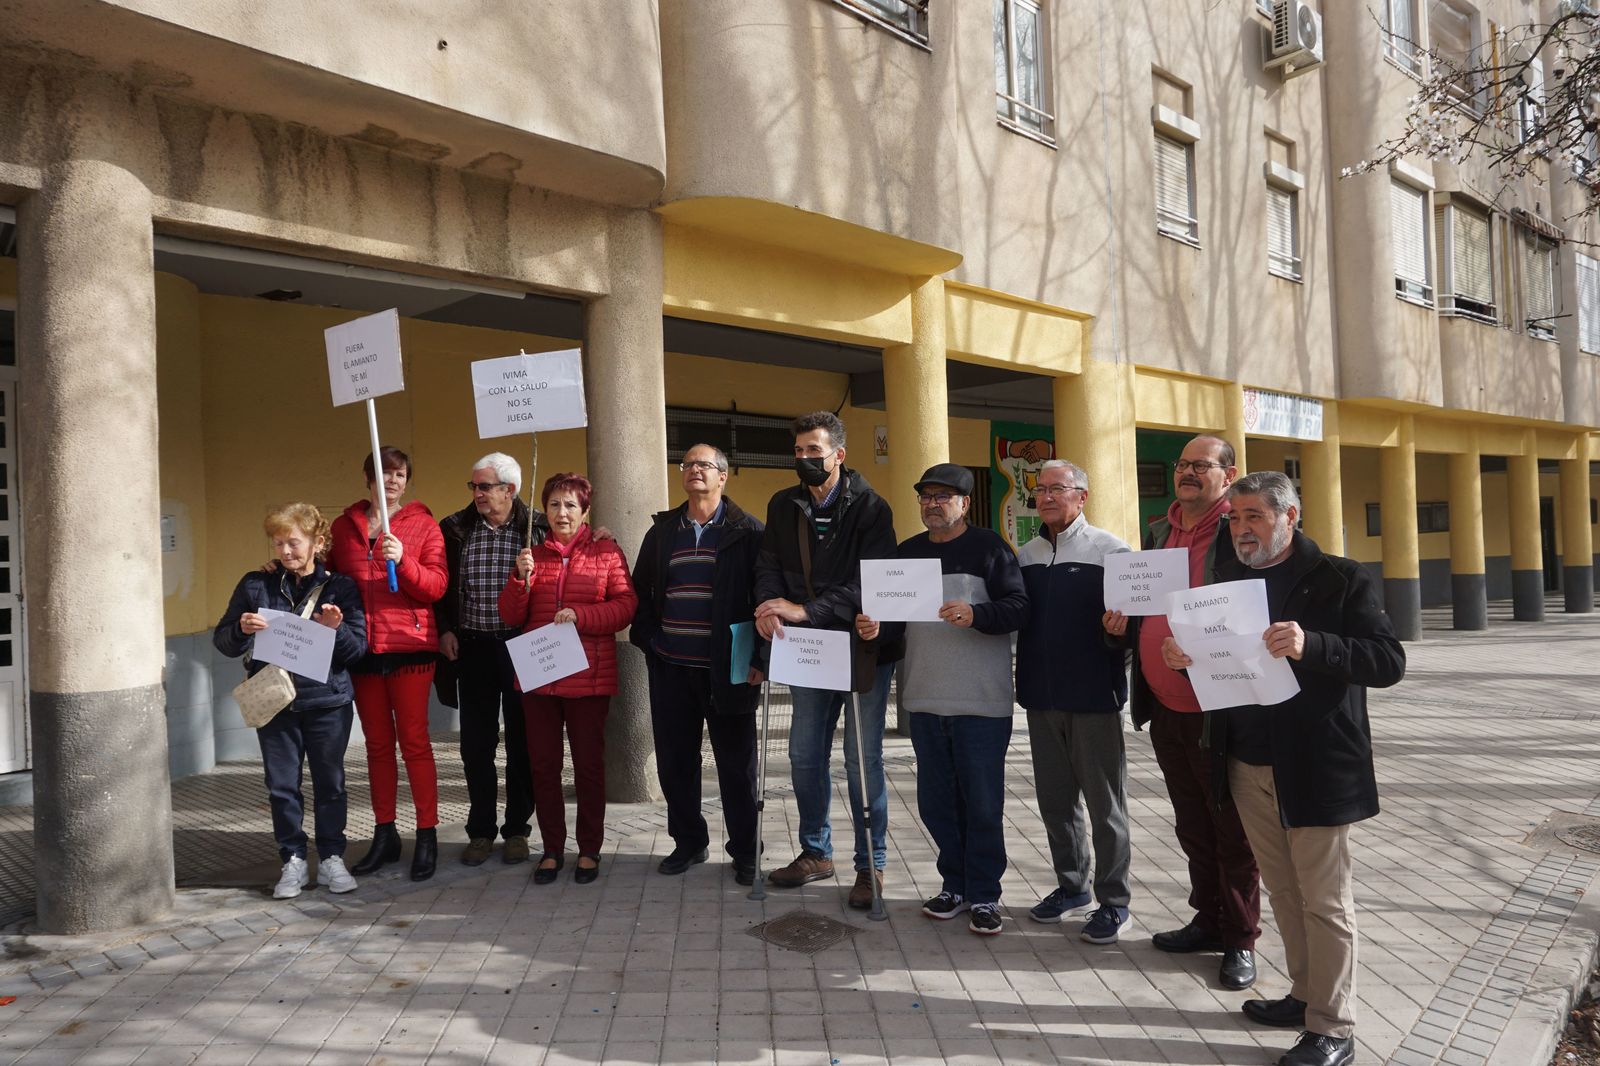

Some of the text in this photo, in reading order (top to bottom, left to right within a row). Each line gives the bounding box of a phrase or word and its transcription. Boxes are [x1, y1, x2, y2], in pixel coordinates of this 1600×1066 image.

[346, 343, 364, 353] FUERA
[350, 354, 378, 368] AMIANTO
[351, 374, 358, 382] DE
[503, 370, 527, 380] IVIMA
[355, 387, 369, 396] CASA
[489, 382, 548, 396] CON LA SALUD
[508, 398, 532, 407] NO SE
[507, 412, 533, 422] JUEGA
[1194, 597, 1228, 609] AMIANTO
[286, 622, 302, 632] IVIMA
[1204, 624, 1227, 635] MATA
[285, 641, 292, 649] NO
[296, 635, 313, 646] SALUD
[531, 636, 548, 646] FUERA
[537, 640, 560, 655] AMIANTO
[281, 652, 297, 660] JUEGA
[1210, 650, 1231, 659] IVIMA
[543, 664, 556, 672] CASA
[1211, 673, 1257, 681] RESPONSABLE
